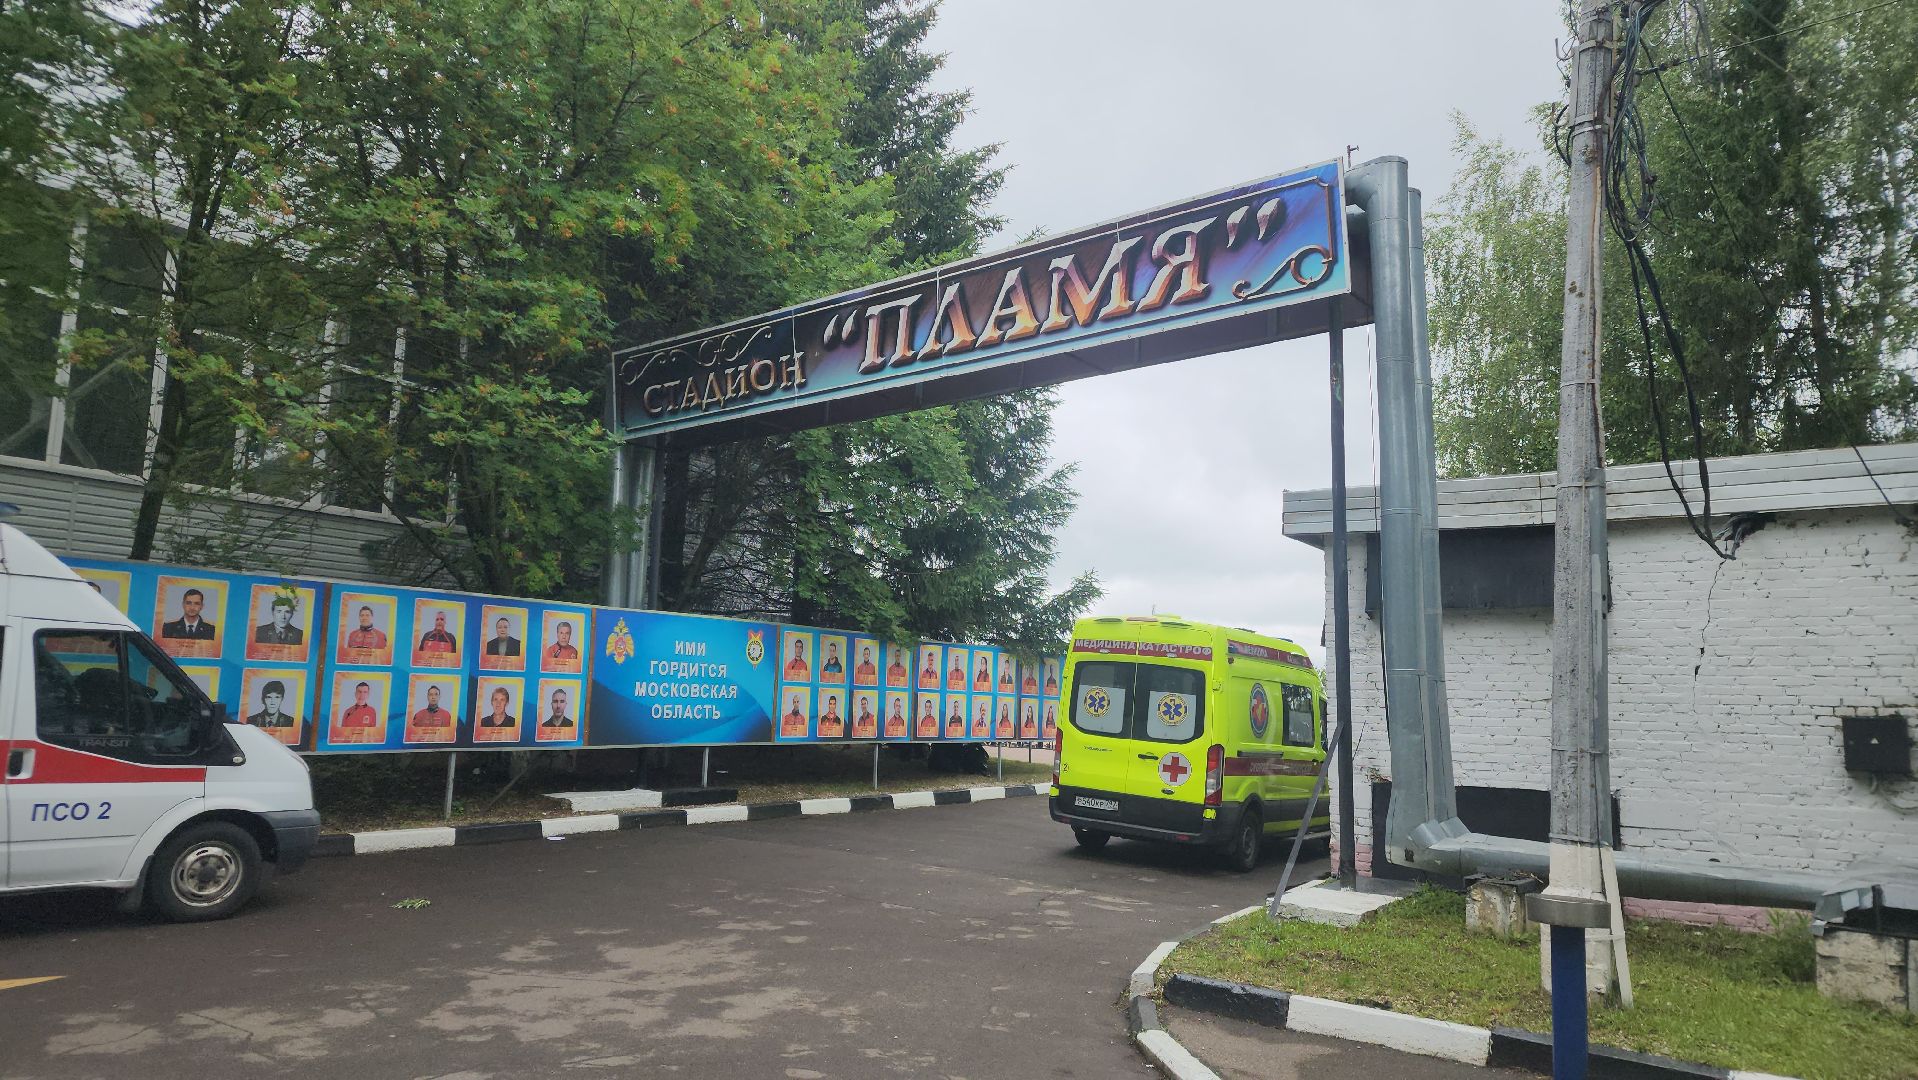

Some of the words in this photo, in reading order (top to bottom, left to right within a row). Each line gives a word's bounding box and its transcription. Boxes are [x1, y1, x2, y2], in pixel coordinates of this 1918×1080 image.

[643, 351, 807, 413] СТАДИОН
[675, 640, 706, 657] ИМИ
[1138, 641, 1212, 656] КАТАСТРОФ
[649, 660, 727, 679] ГОРДИТСЯ
[634, 681, 738, 699] МОСКОВСКАЯ
[651, 703, 721, 720] ОБЛАСТЬ
[31, 802, 90, 822] ПСО
[97, 801, 112, 820] 2
